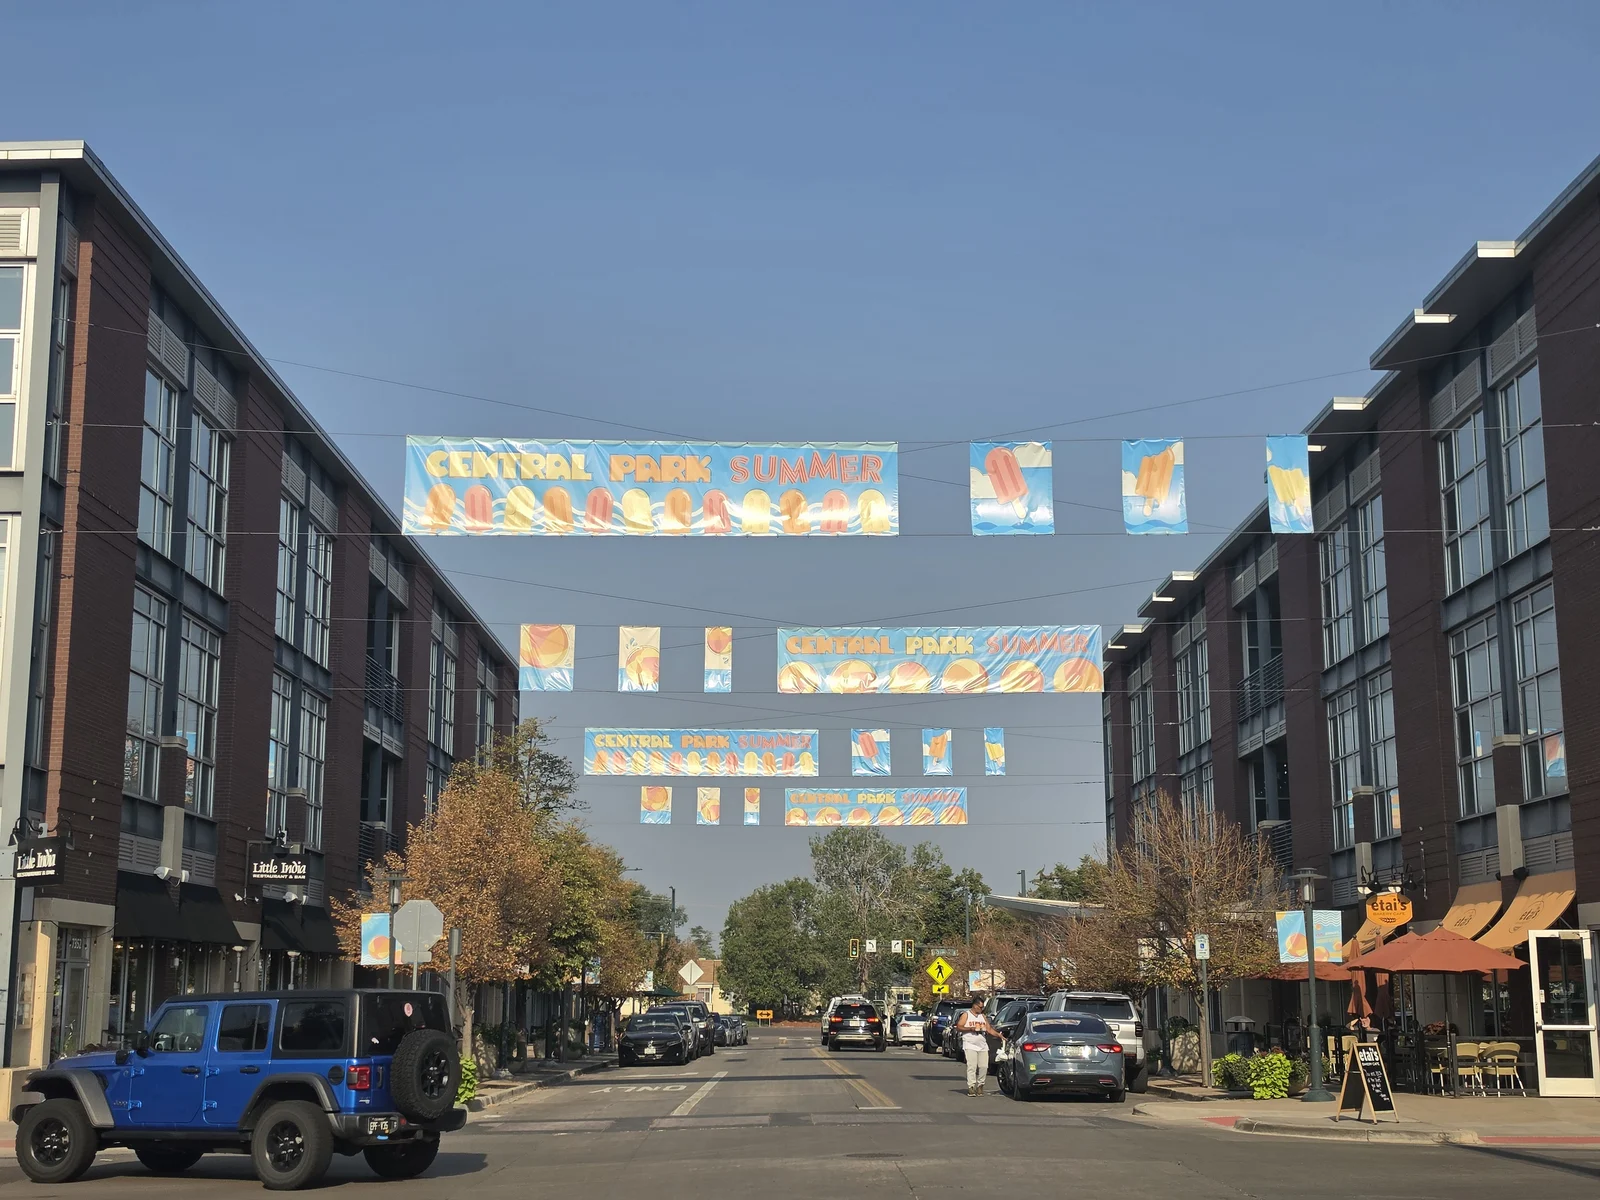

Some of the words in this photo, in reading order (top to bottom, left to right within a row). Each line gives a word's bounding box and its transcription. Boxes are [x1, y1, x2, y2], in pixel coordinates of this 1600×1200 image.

[426, 450, 592, 481] CENTRAL
[609, 454, 712, 483] PARK
[730, 451, 883, 485] SUMMER
[785, 635, 895, 655] CENTRAL
[905, 635, 975, 656] PARK
[986, 632, 1088, 656] SUMMER
[593, 733, 673, 749] CENTRAL
[680, 734, 730, 749] PARK
[737, 733, 812, 750] SUMMER
[790, 792, 851, 805] CENTRAL
[857, 793, 896, 805] PARK
[36, 848, 57, 868] India
[252, 859, 279, 874] Little
[280, 860, 307, 874] India
[1371, 898, 1407, 911] etai's
[1358, 1047, 1380, 1062] etai's
[588, 1084, 687, 1093] ONLY
